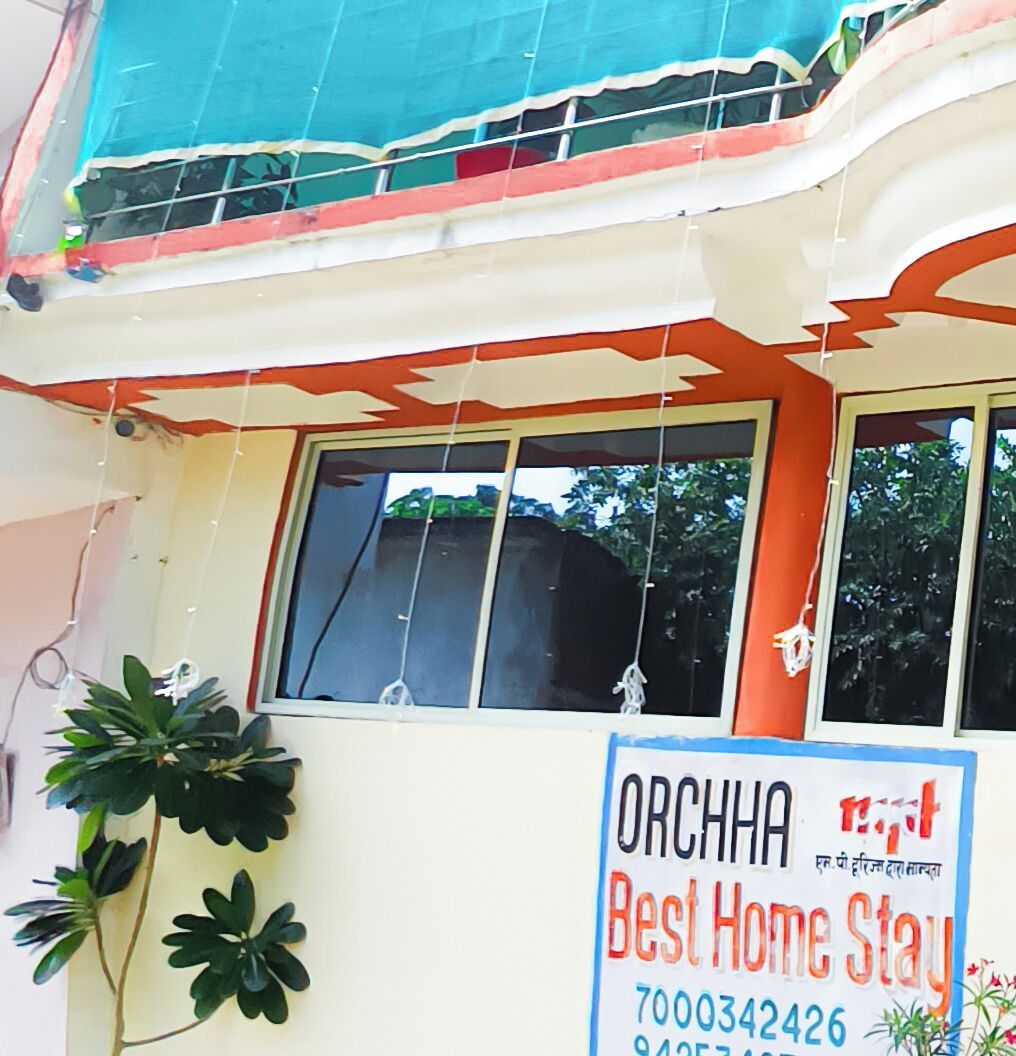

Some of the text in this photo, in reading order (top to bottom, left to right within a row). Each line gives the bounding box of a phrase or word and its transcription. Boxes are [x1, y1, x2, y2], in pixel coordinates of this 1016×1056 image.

[617, 773, 793, 868] ORCHHA
[608, 870, 953, 1017] Best Home Stay
[636, 986, 847, 1048] 7000342426
